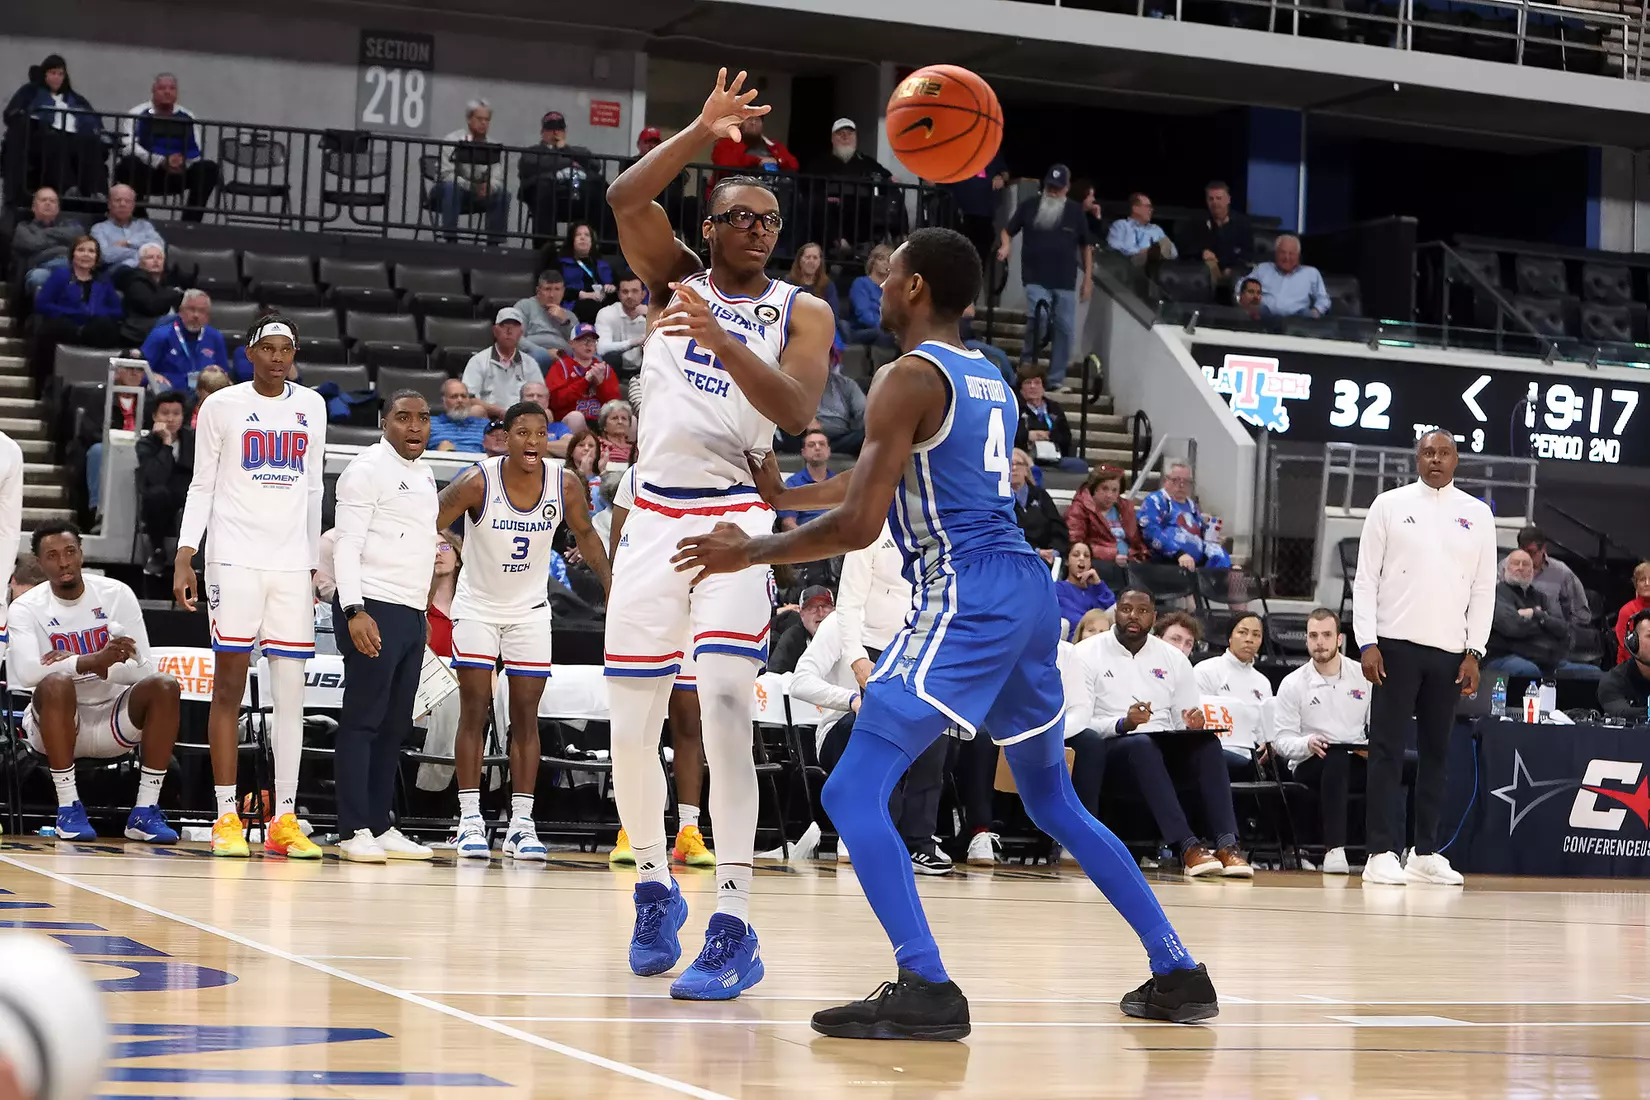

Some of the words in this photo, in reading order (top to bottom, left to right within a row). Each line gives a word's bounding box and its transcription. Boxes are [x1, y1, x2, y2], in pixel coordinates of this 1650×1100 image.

[365, 38, 430, 62] SECTION
[363, 65, 424, 128] 218
[707, 300, 766, 340] ISIANA
[684, 369, 730, 397] TECH
[964, 374, 1007, 403] BUFFORD
[1329, 379, 1392, 430] 32
[1524, 381, 1639, 435] 19:17
[241, 428, 308, 475] OUR
[983, 407, 1012, 497] 4
[1471, 428, 1485, 452] 3
[1589, 437, 1621, 464] 2ND
[251, 473, 299, 482] MOMENT
[492, 518, 552, 532] LOUISIANA
[511, 536, 530, 560] 3
[502, 562, 531, 573] TECH
